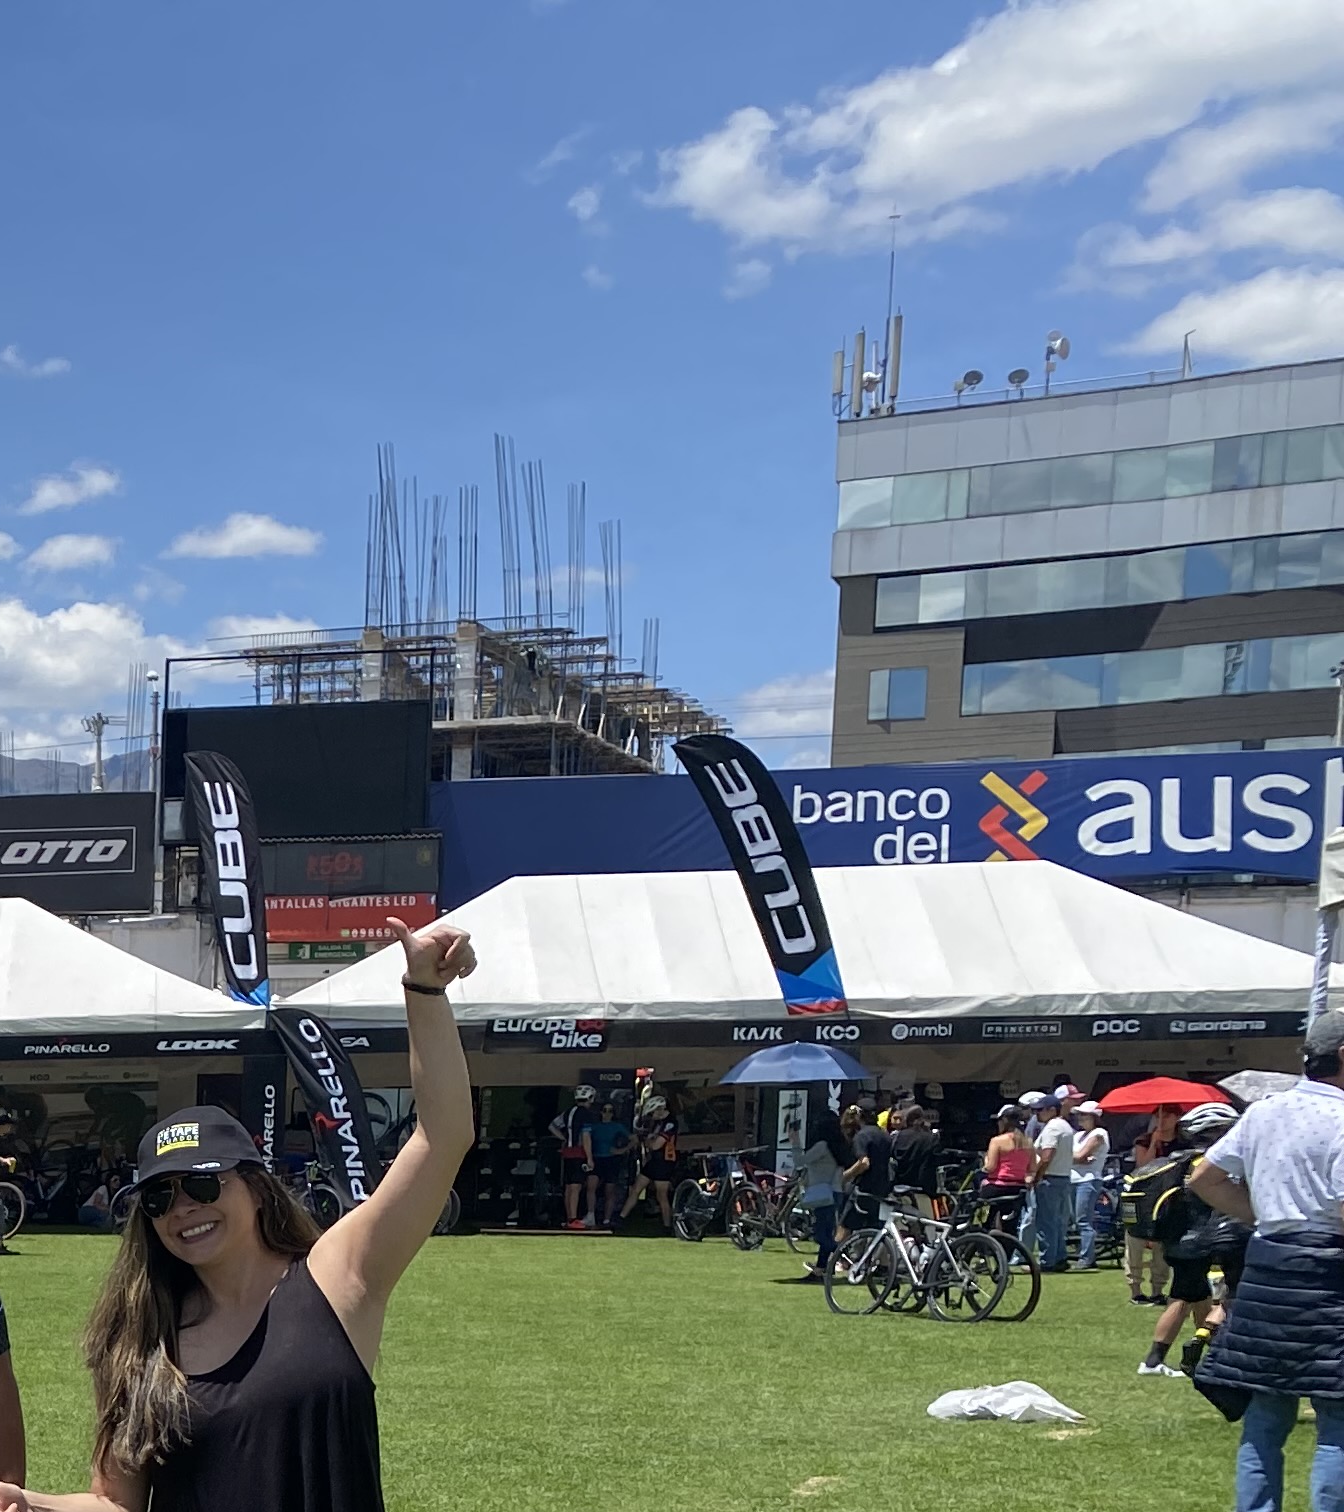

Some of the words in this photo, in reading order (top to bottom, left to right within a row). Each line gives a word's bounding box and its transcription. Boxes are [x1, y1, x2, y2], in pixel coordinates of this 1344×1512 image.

[792, 784, 951, 824] banco
[705, 758, 817, 956] CUBE
[873, 824, 951, 864] del
[203, 781, 259, 980] CUBE
[394, 895, 416, 906] LED
[24, 1043, 110, 1055] PINARELLO
[551, 1031, 603, 1048] bike
